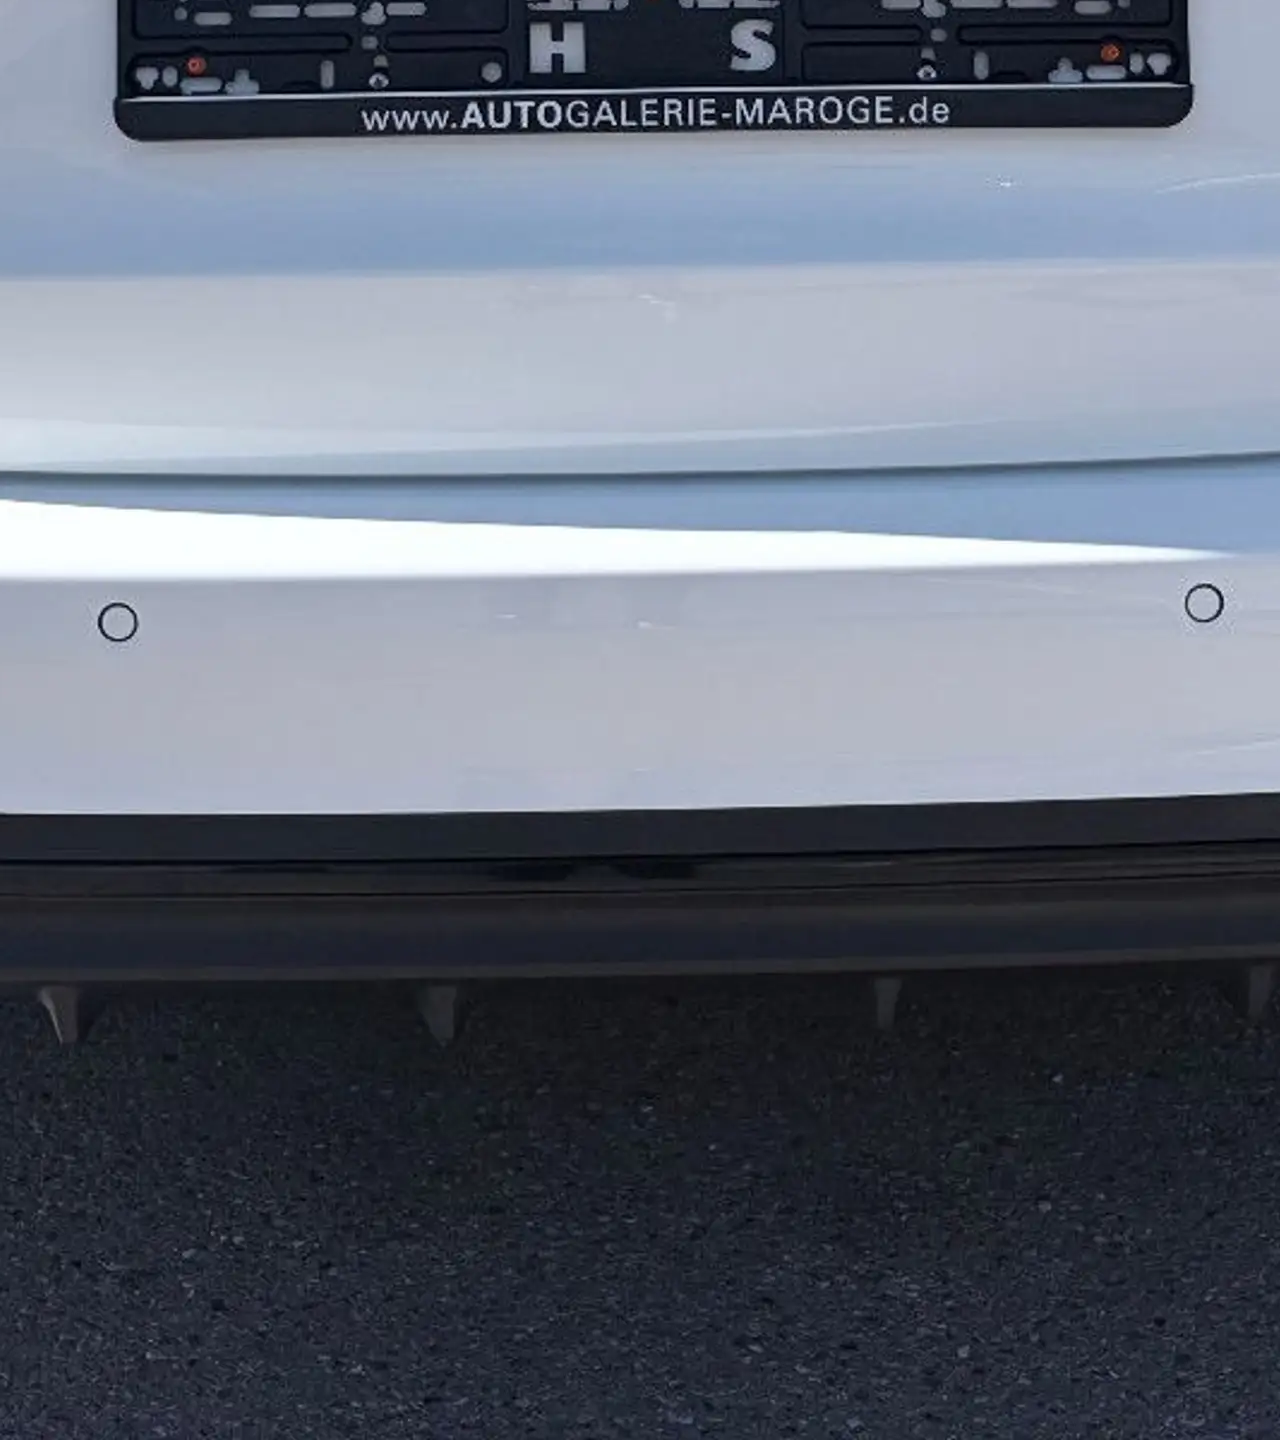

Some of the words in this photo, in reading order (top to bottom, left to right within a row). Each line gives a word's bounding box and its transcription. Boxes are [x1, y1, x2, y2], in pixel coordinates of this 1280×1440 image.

[528, 21, 587, 74] H
[729, 18, 777, 72] S
[360, 95, 951, 133] www.AUTOGALERIE-MAROGE.de
